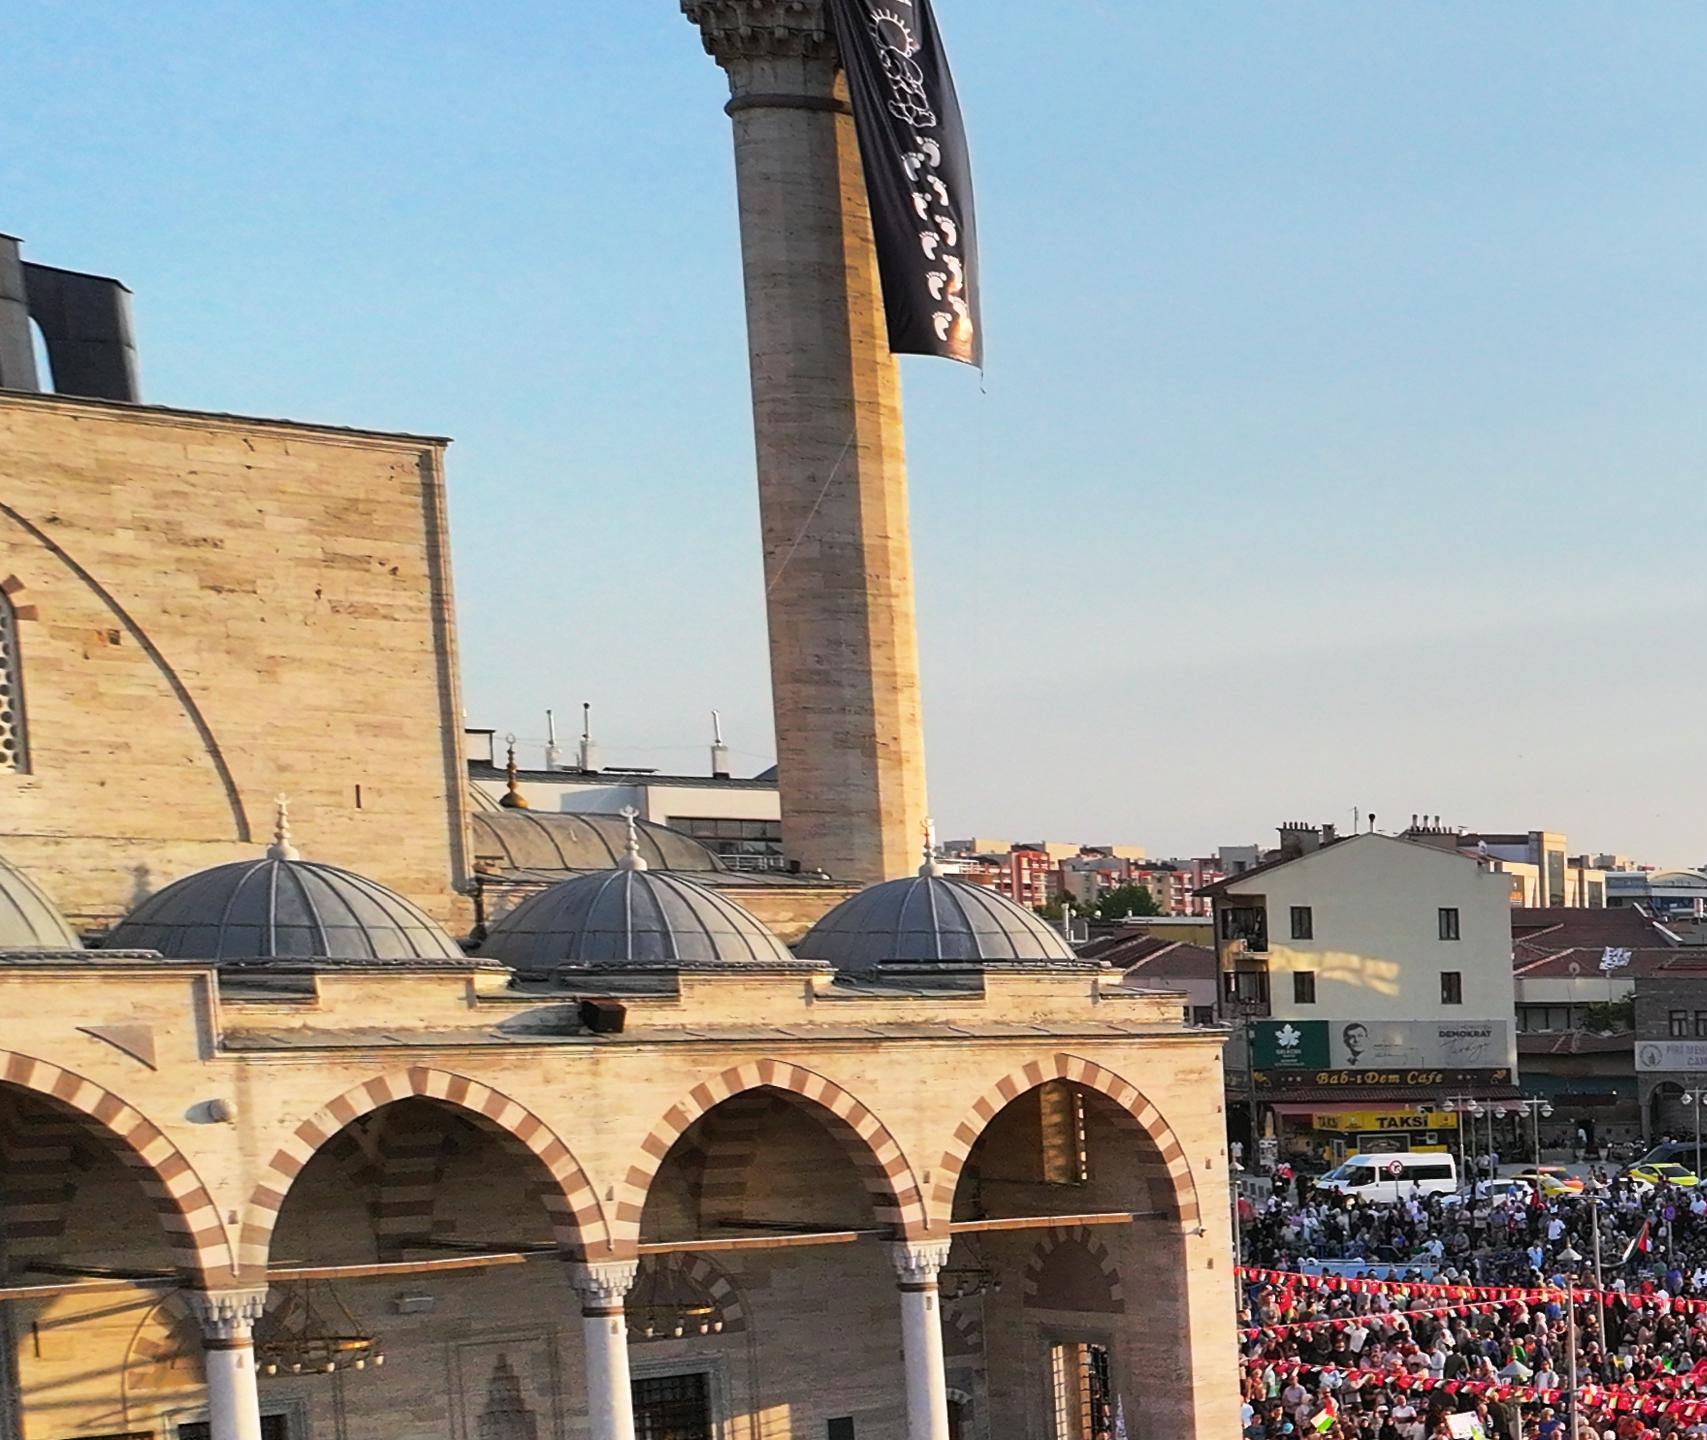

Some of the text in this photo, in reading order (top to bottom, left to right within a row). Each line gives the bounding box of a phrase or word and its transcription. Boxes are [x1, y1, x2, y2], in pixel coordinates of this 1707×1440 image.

[1438, 1030, 1492, 1038] DEMOKRAT
[1366, 1071, 1400, 1084] Dem
[1407, 1070, 1443, 1085] Cafe
